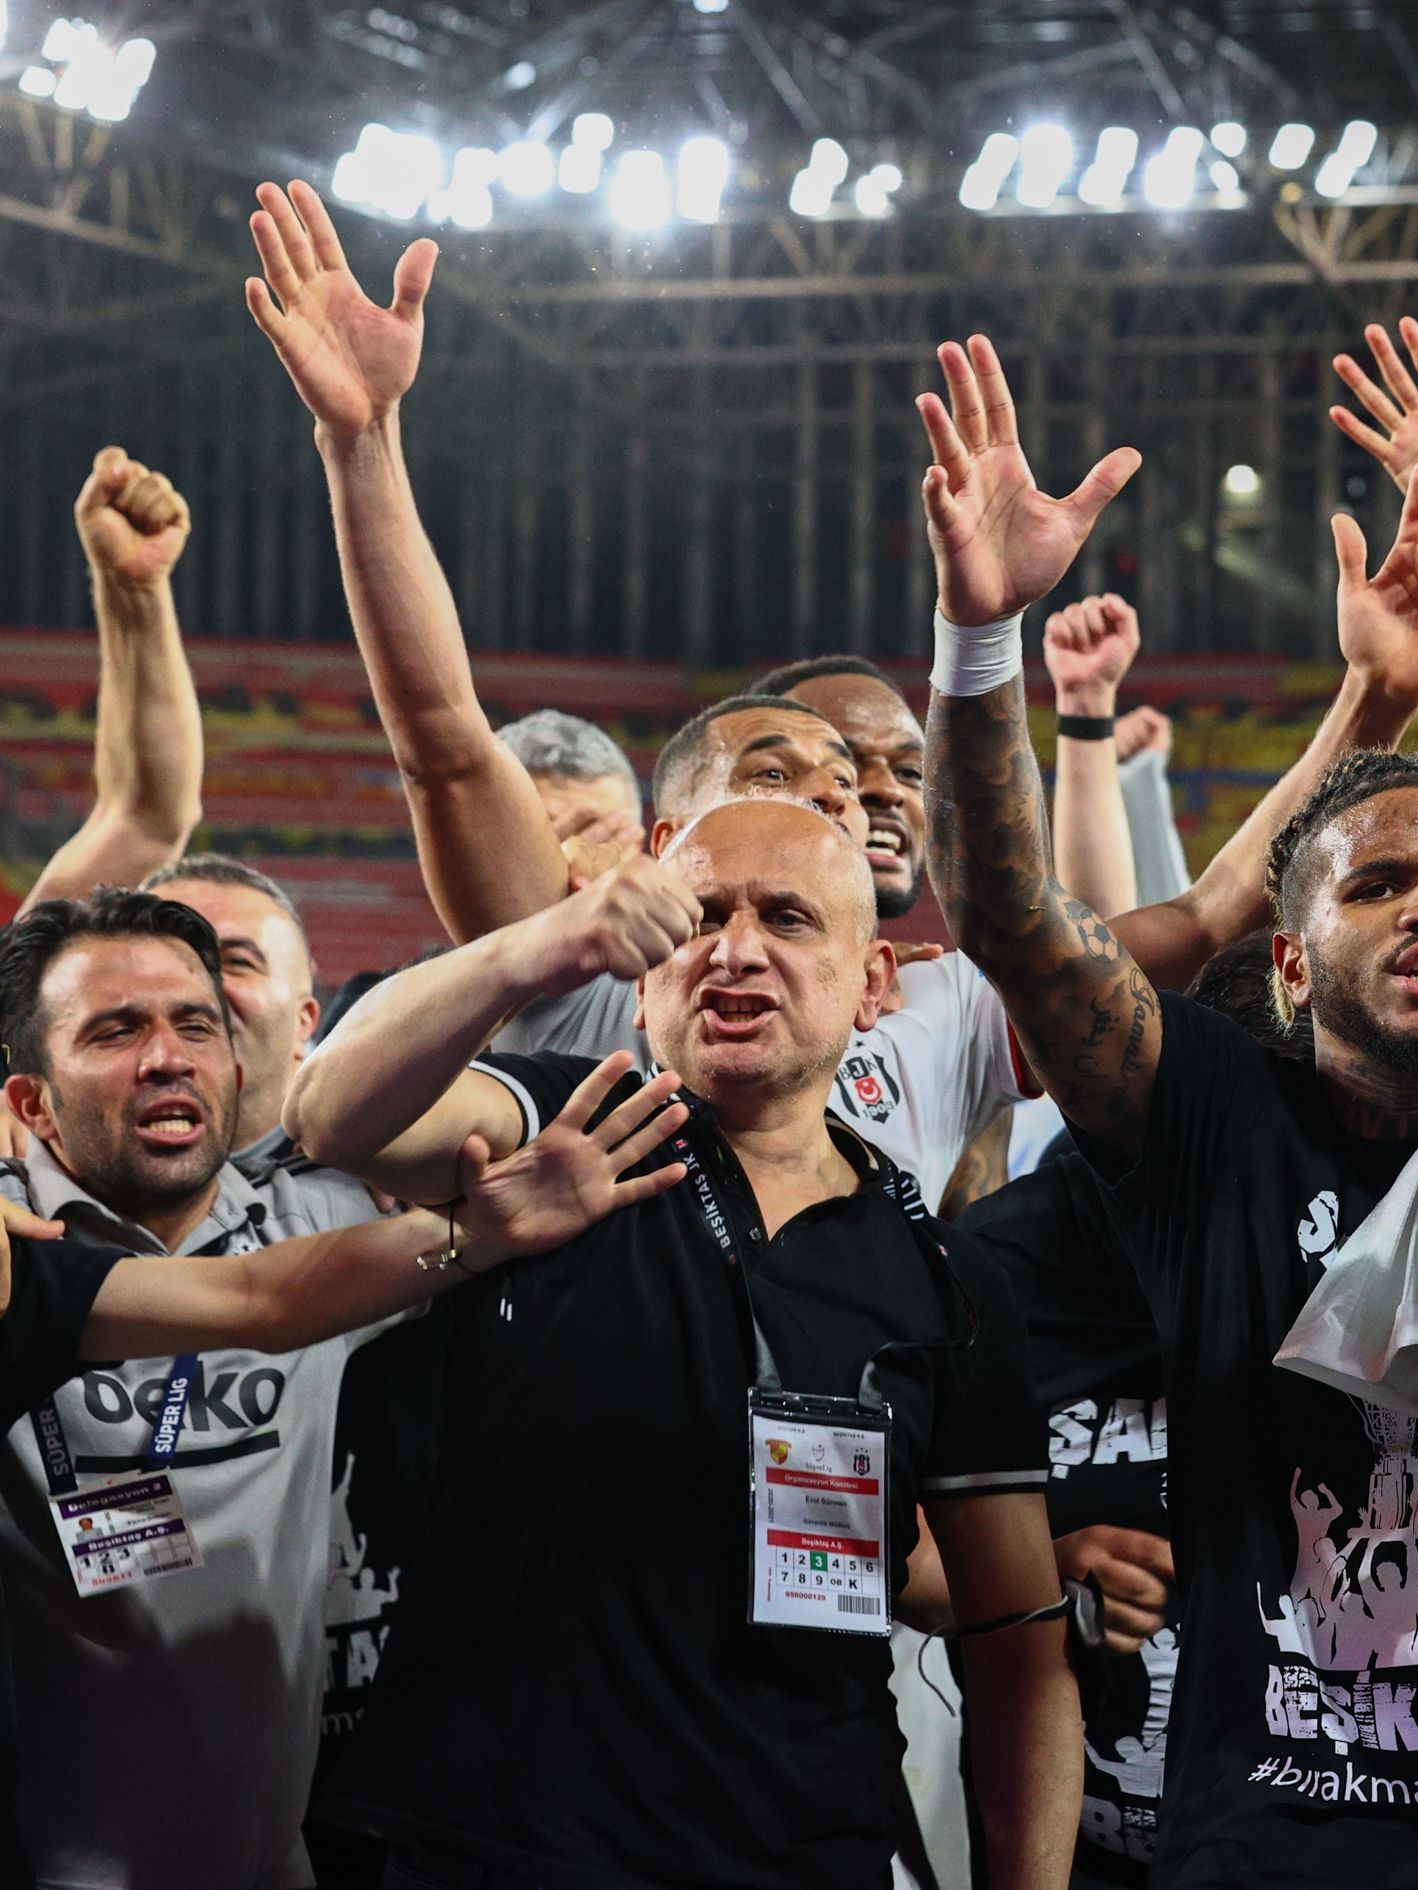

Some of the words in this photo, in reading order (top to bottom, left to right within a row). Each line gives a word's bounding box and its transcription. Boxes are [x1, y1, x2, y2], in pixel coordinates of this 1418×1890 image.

[862, 1100, 895, 1119] 1903
[154, 1404, 182, 1454] SÜPER
[784, 1474, 829, 1487] Organizasyon
[67, 1486, 150, 1513] Delegasyon
[801, 1537, 830, 1549] Beşiktaş
[781, 1552, 788, 1563] 1
[798, 1554, 806, 1565] 2
[814, 1556, 823, 1567] 3
[831, 1558, 840, 1569] 4
[849, 1560, 857, 1571] 5
[865, 1562, 874, 1572] 6
[781, 1572, 789, 1582] 7
[798, 1573, 806, 1584] 8
[815, 1575, 823, 1586] 9
[849, 1579, 858, 1590] K
